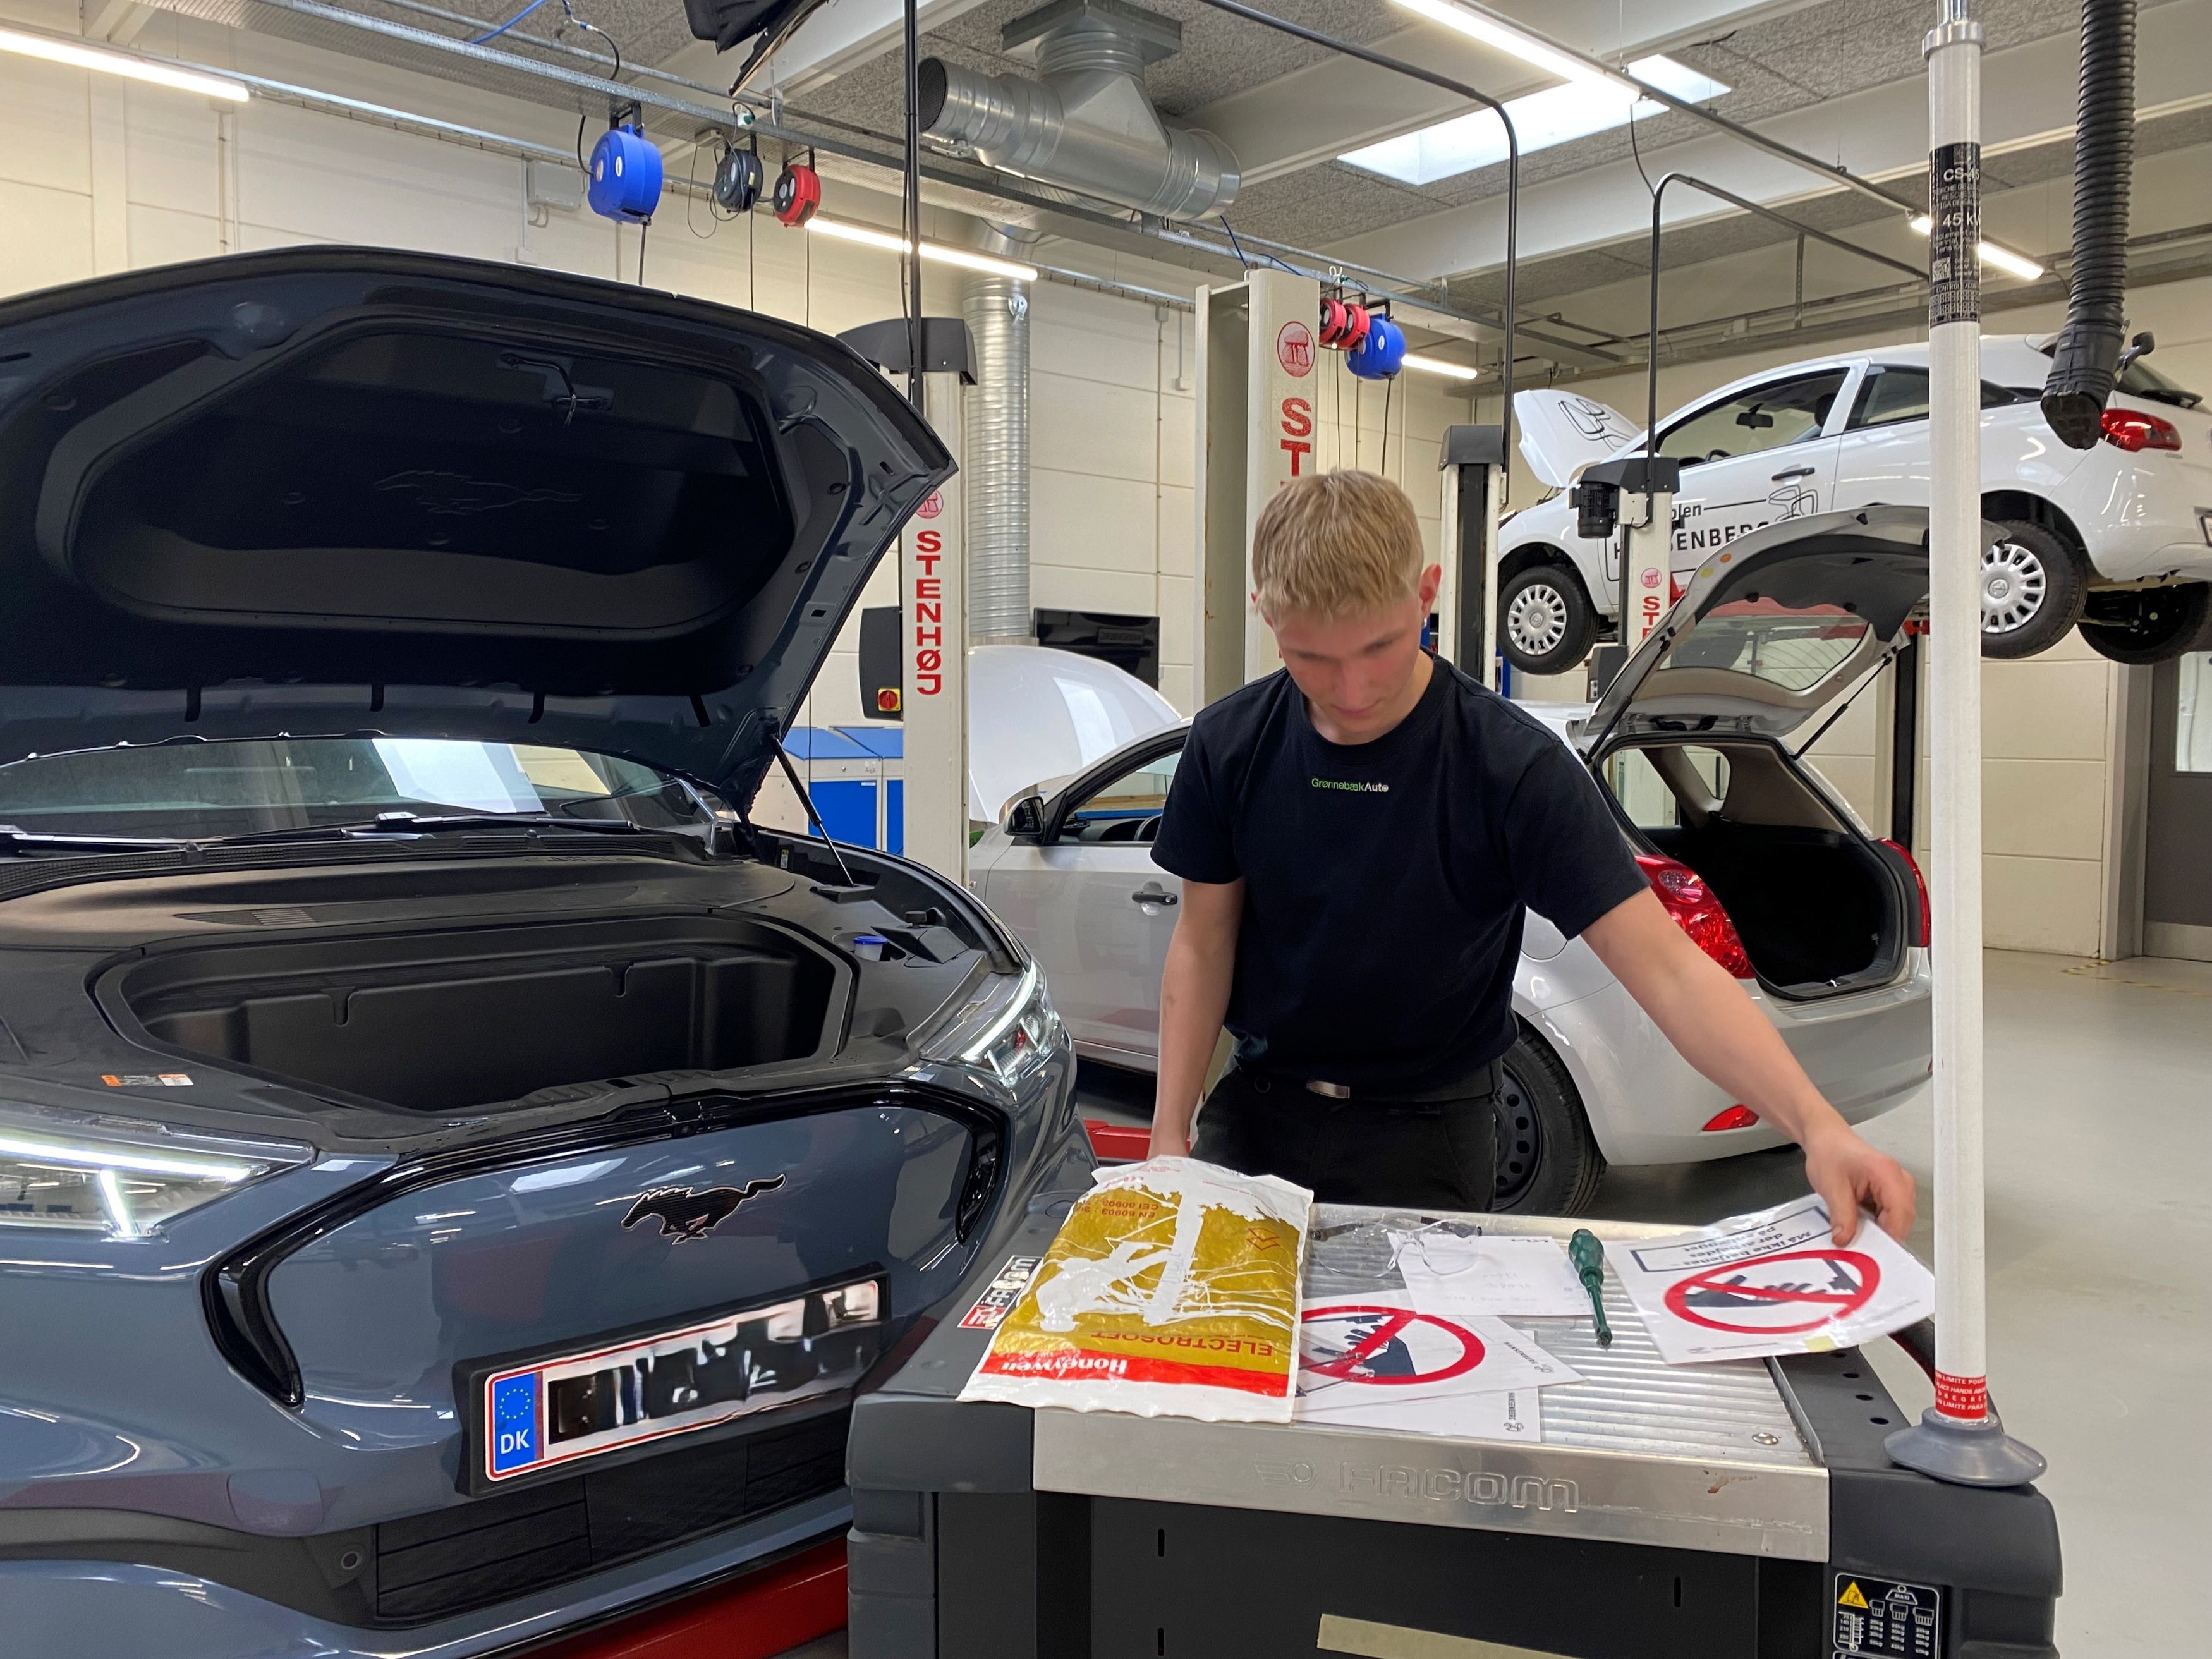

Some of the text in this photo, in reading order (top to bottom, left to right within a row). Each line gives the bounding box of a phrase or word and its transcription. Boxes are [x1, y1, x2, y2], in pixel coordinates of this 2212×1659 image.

[1943, 212, 1963, 228] 45
[916, 530, 942, 695] STENHØJ
[1311, 778, 1389, 793] GrønnebækAuto
[1139, 1203, 1158, 1211] CEI
[1101, 1208, 1136, 1218] 60903
[1758, 1233, 1783, 1244] der
[1753, 1241, 1785, 1252] ikke
[1943, 1375, 1966, 1384] LIMITE
[1943, 1401, 1966, 1410] LIMITE
[501, 1428, 530, 1454] DK
